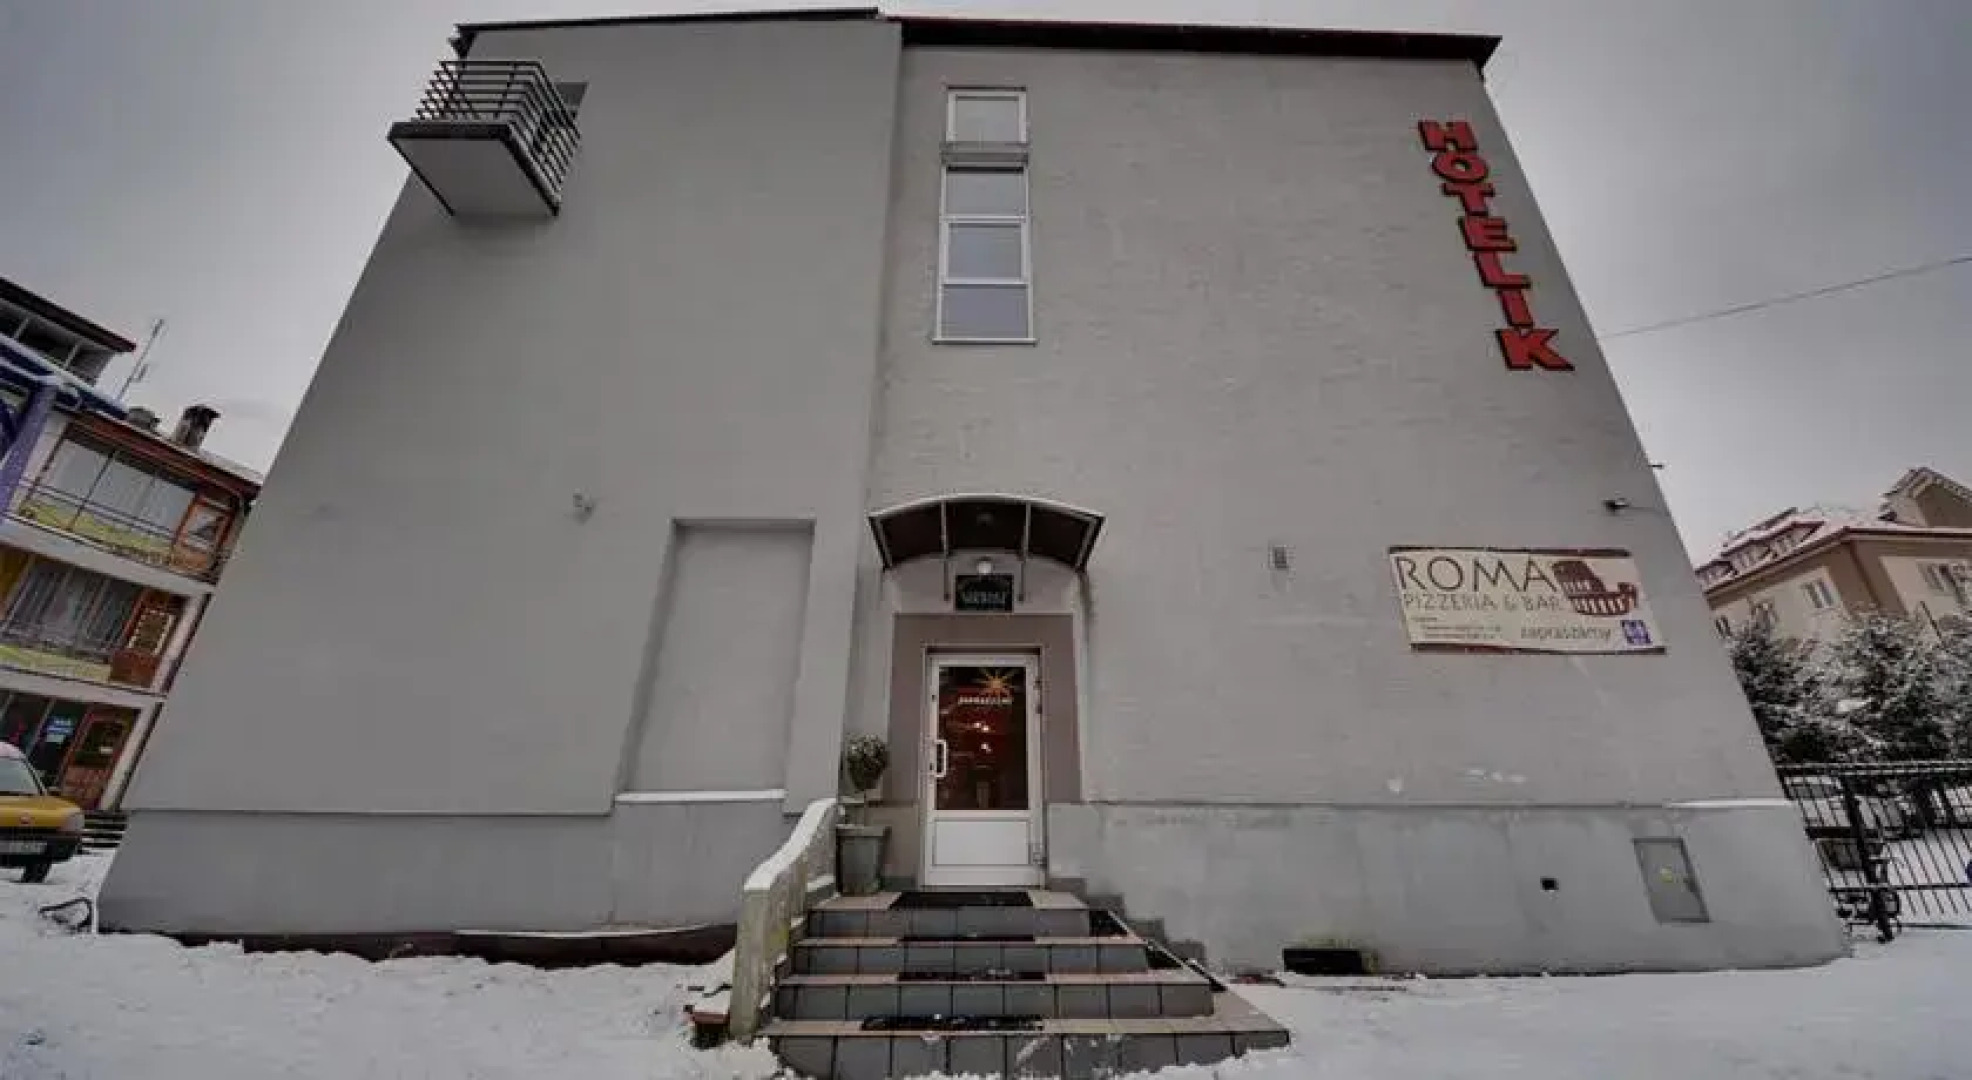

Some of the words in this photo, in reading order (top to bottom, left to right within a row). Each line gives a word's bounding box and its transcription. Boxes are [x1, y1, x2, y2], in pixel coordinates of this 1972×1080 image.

[1418, 120, 1575, 371] HOTELIK
[1396, 555, 1557, 592] ROMA
[1403, 593, 1496, 611] PIZZERIA
[1524, 594, 1560, 611] BAR
